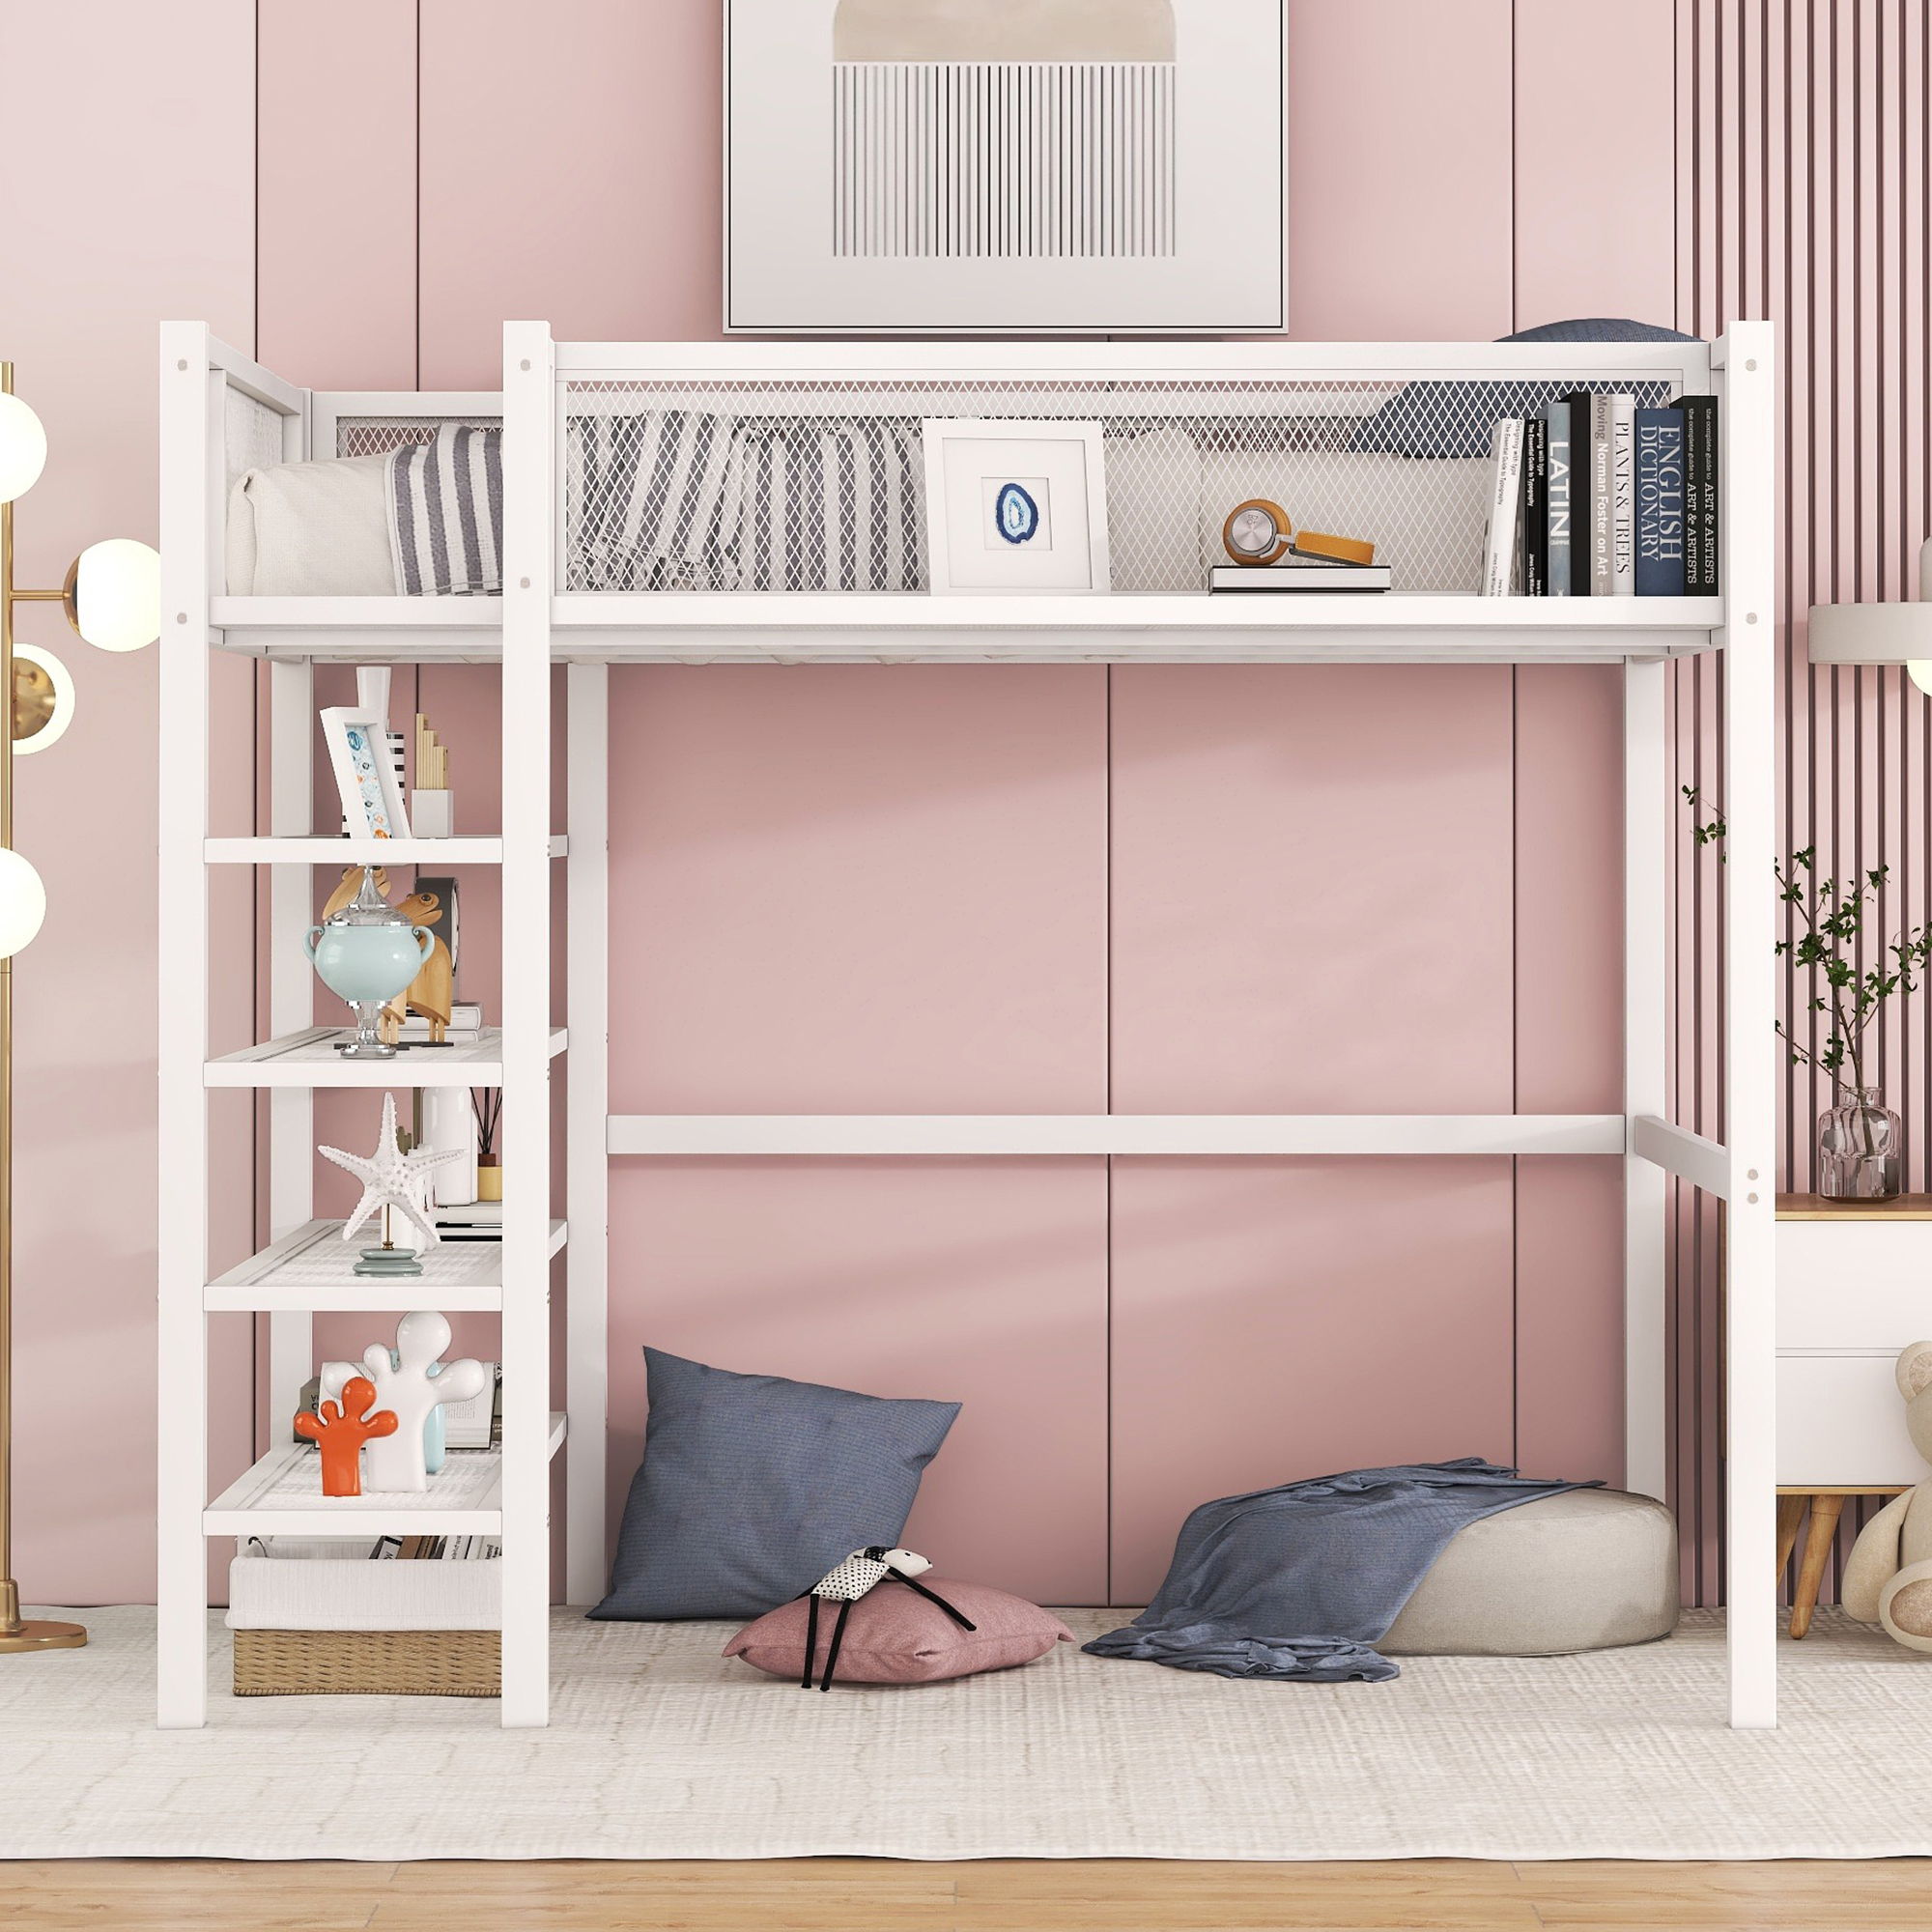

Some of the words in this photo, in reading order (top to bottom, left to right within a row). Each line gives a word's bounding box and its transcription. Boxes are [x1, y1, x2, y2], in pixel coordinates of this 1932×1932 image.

[1512, 421, 1522, 449] Designing
[1536, 420, 1545, 449] Designing
[1595, 396, 1608, 440] Moving
[1536, 464, 1545, 476] type
[1597, 443, 1608, 493] Norman
[1616, 422, 1630, 492] PLANTS
[1549, 441, 1570, 537] LATIN
[1616, 496, 1630, 509] &
[1640, 425, 1659, 562] DICTIONARY
[1659, 425, 1682, 561] ENGLISH
[1688, 483, 1696, 511] ART
[1705, 483, 1714, 511] ART
[1597, 496, 1608, 535] Foster
[1688, 513, 1696, 526] &
[1705, 513, 1714, 526] &
[1597, 537, 1605, 553] on
[1616, 514, 1630, 574] TREES
[1688, 526, 1696, 584] ARTISTS
[1705, 526, 1714, 584] ARTISTS
[1597, 555, 1608, 576] Art
